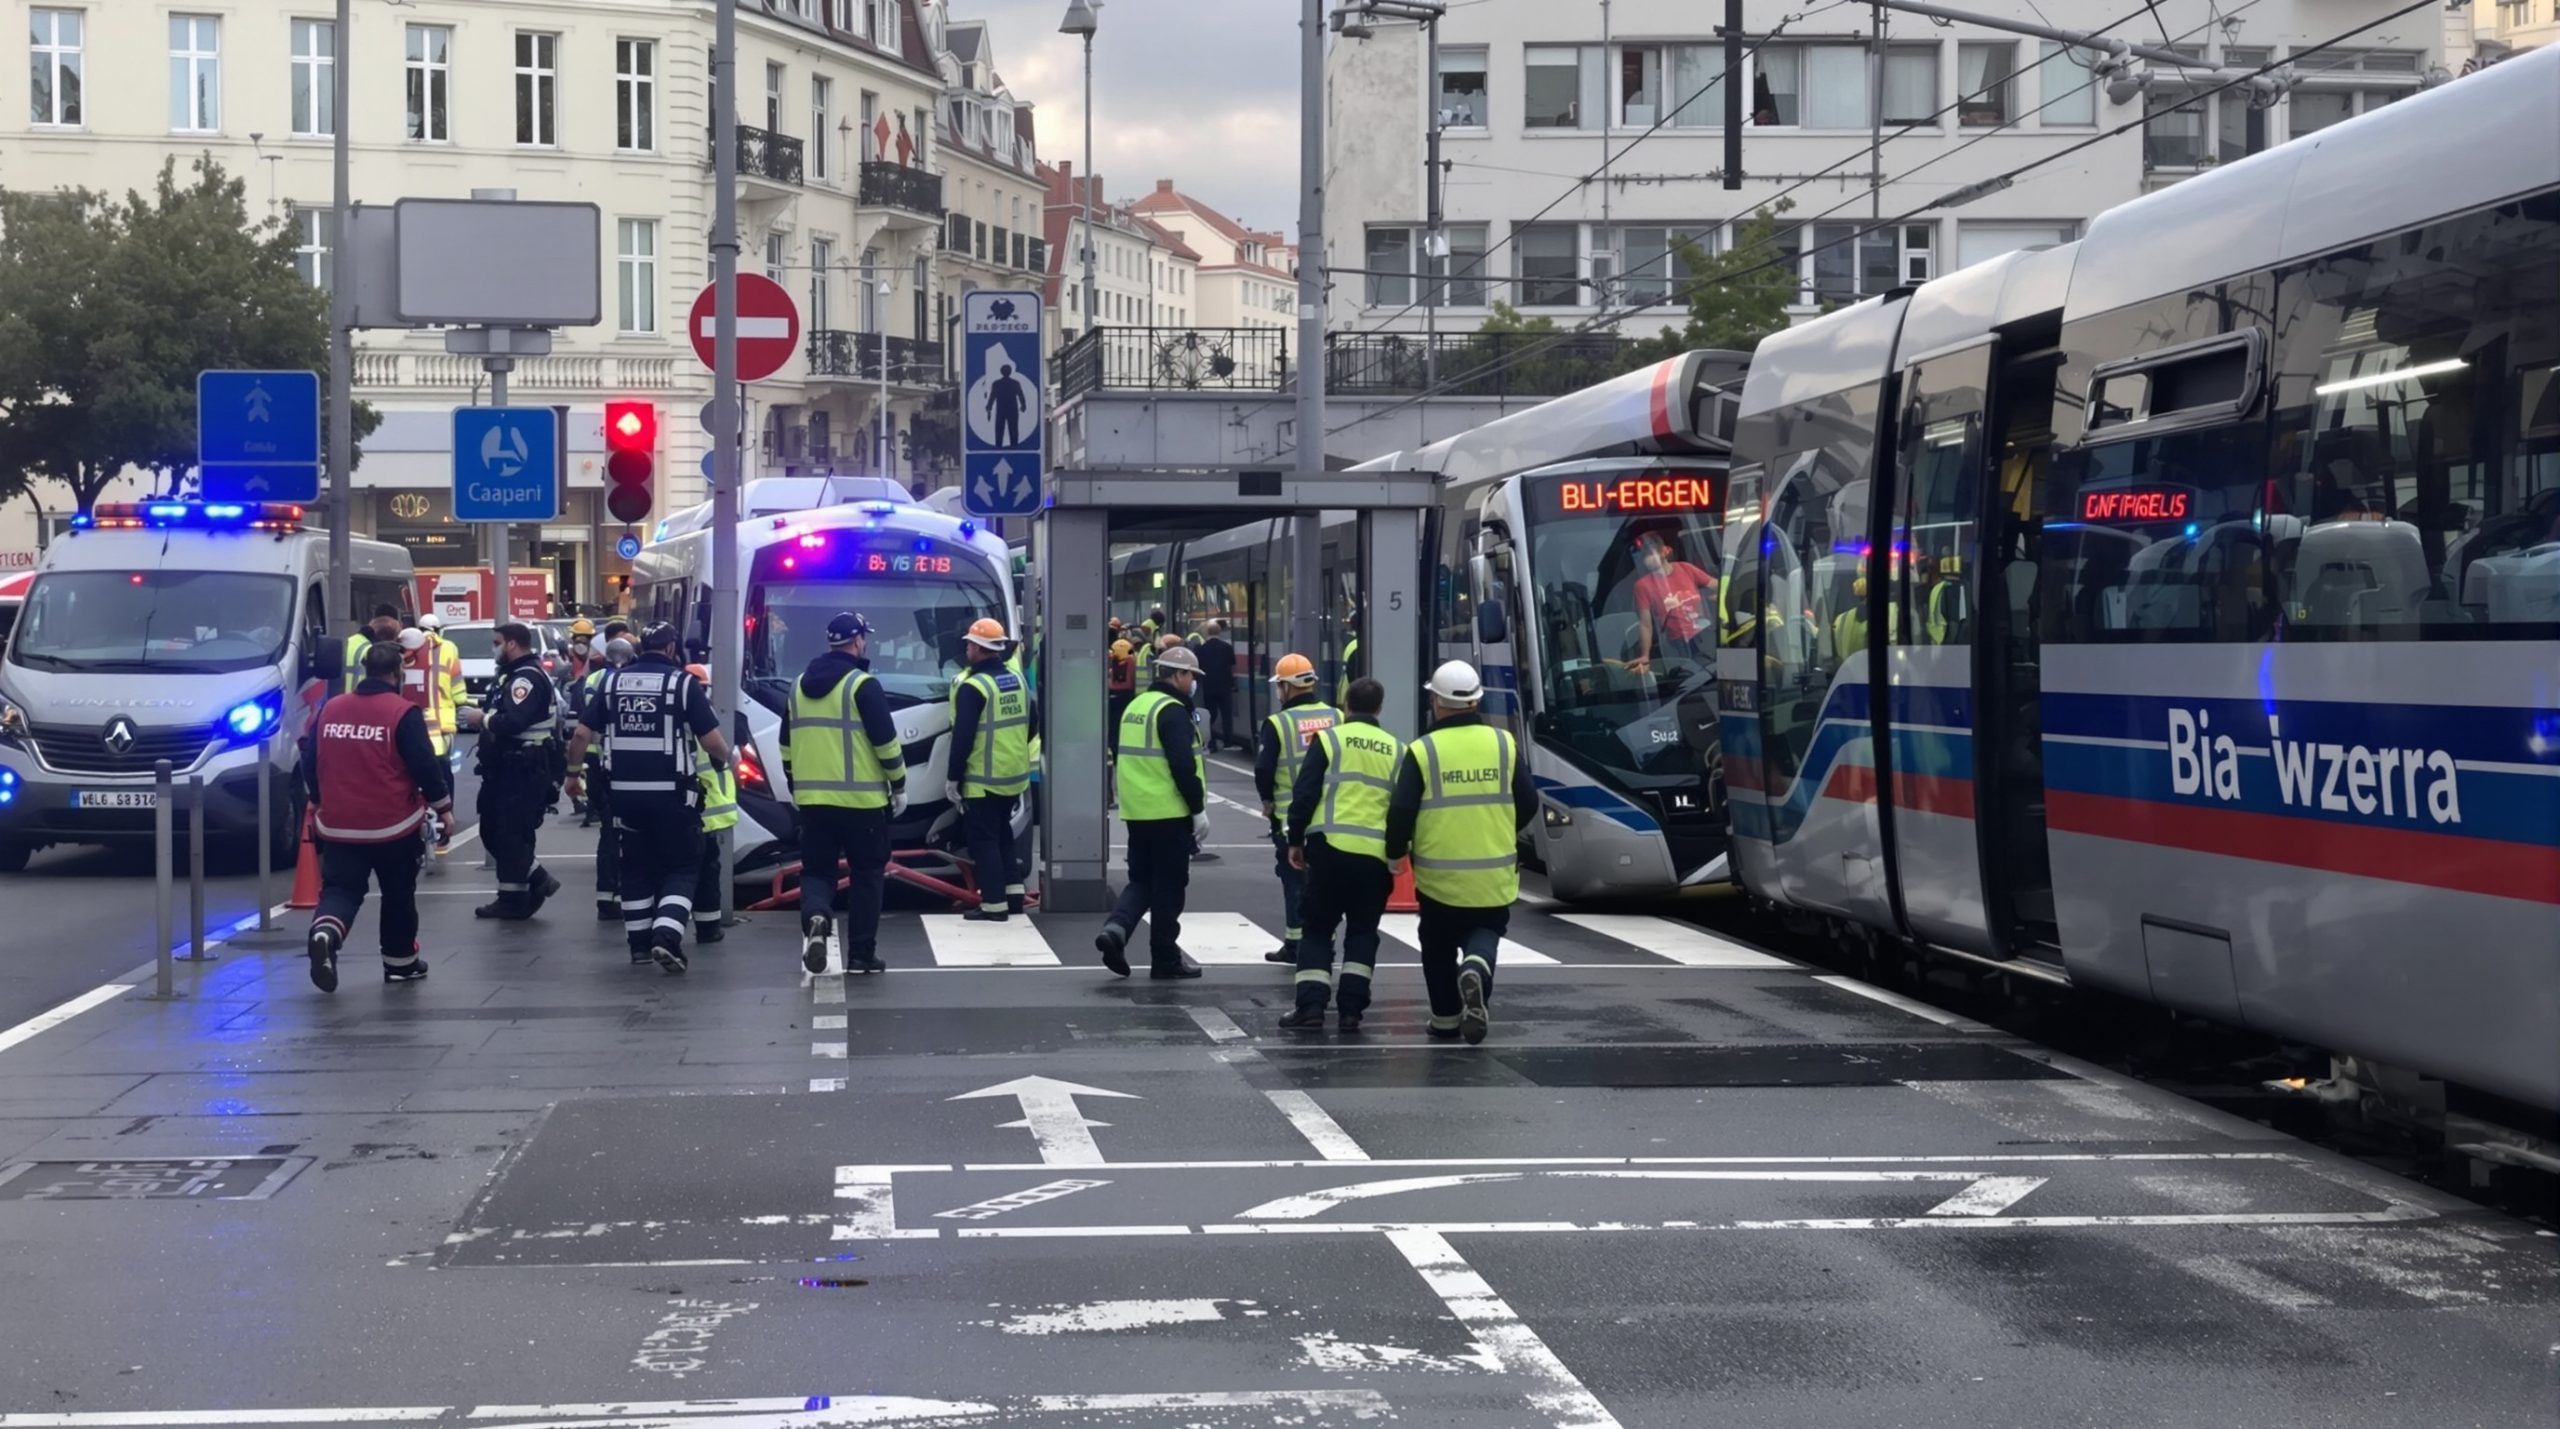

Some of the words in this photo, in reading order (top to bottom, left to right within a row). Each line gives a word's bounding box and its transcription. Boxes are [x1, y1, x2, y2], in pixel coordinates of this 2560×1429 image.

[1562, 479, 1711, 510] BLI-ERGEN
[1390, 591, 1402, 611] 5
[2168, 708, 2241, 801] Bia
